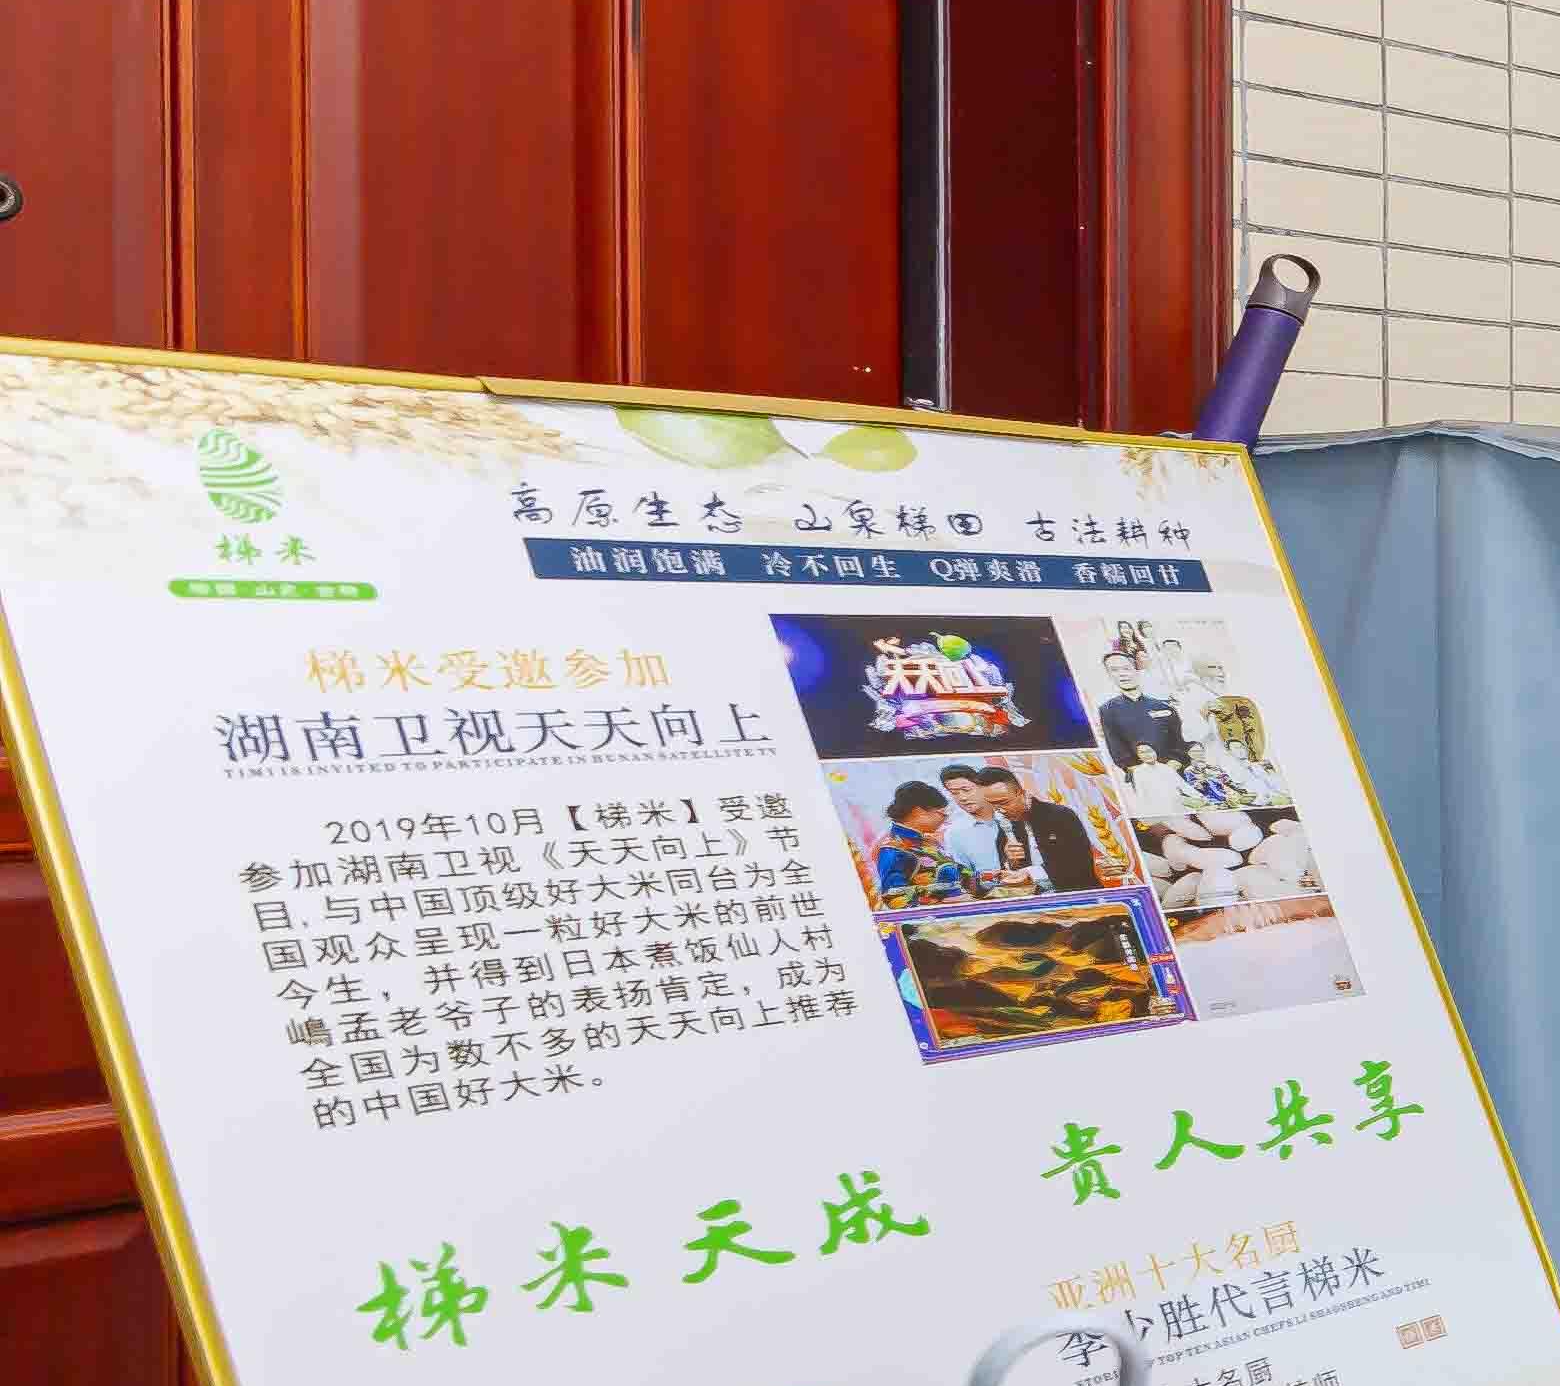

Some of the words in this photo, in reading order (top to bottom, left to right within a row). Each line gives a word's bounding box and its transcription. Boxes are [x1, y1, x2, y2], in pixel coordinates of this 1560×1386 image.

[511, 482, 744, 534] 高原生态
[760, 550, 901, 581] 冷不回生
[303, 647, 672, 696] 梯米受邀参加
[214, 701, 773, 764] 湖南卫视天天向上
[240, 827, 800, 892] 参加湖南卫视《天天向上》节
[262, 891, 826, 974] 国观众呈现一粒好大米的前世
[302, 988, 858, 1091] 全国为数不多的天天向上推荐
[313, 1070, 611, 1132] 的中国好大米。
[1040, 1059, 1424, 1207] 贵人共享
[354, 1170, 931, 1353] 梯米天成
[1048, 1220, 1302, 1311] 亚洲十大名厨
